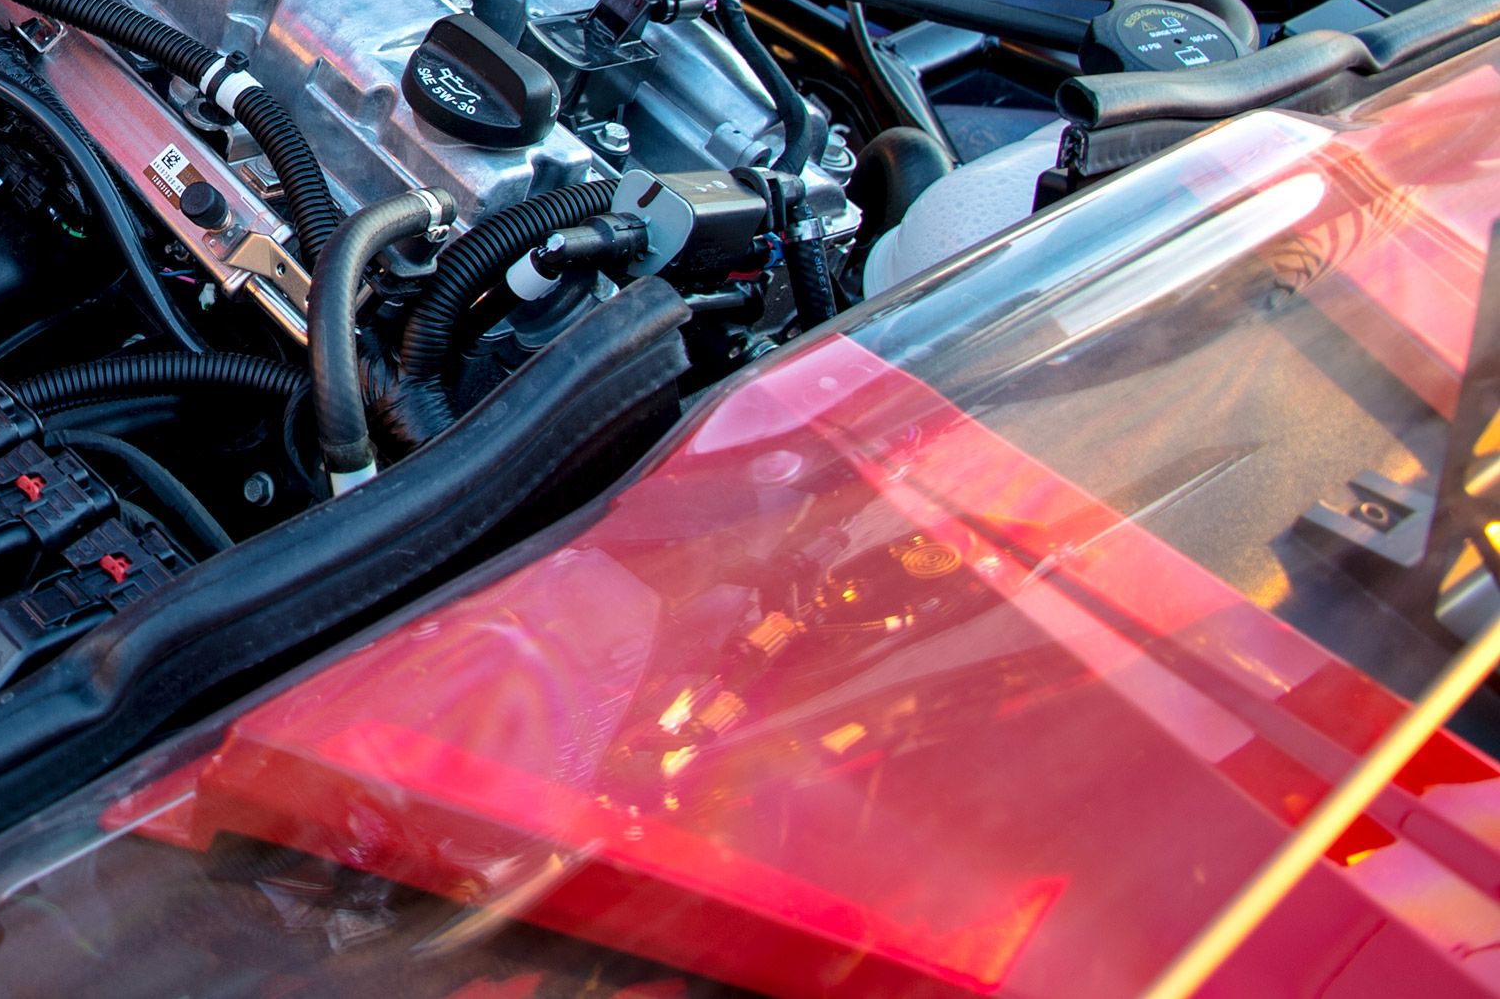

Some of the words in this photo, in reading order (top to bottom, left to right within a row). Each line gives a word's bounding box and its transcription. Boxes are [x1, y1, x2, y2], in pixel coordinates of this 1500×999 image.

[1140, 8, 1167, 17] OPEN
[417, 67, 437, 86] SAE
[431, 86, 477, 115] 5W-30
